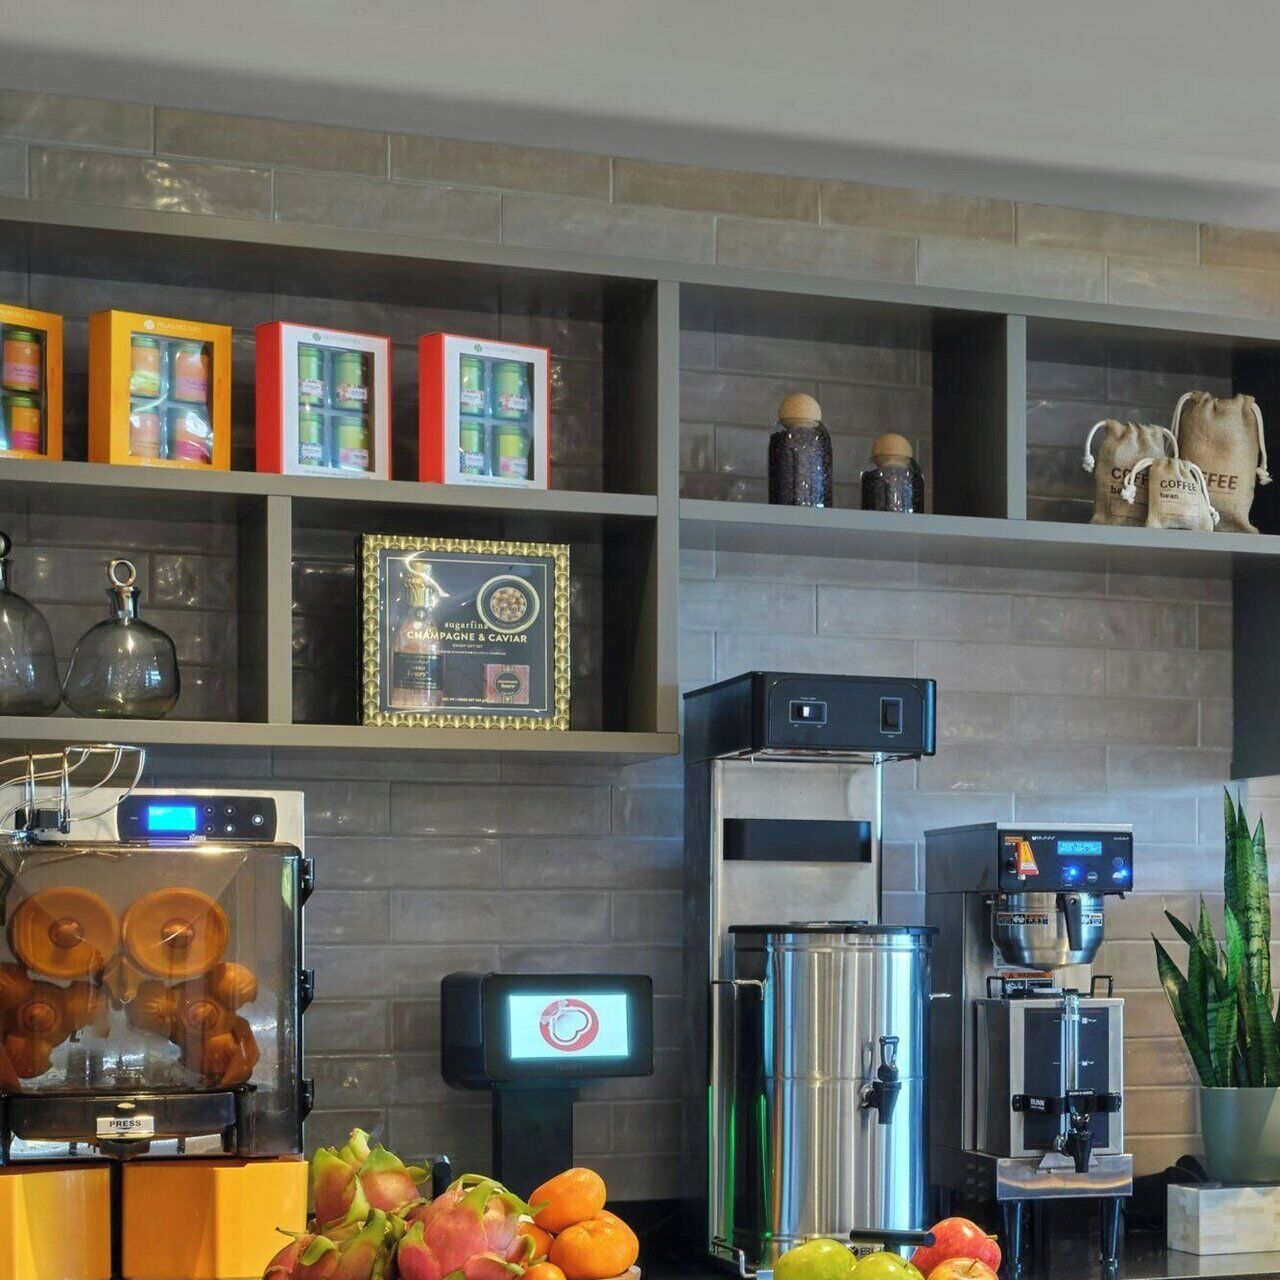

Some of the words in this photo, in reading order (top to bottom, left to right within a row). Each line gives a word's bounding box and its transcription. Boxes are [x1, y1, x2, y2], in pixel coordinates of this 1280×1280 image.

[1160, 480, 1197, 492] COFFEE
[1160, 492, 1179, 500] bean
[406, 630, 475, 642] CHAMPAGNE
[478, 634, 486, 642] &
[488, 634, 528, 643] CAVIAR
[110, 1120, 142, 1128] PRESS
